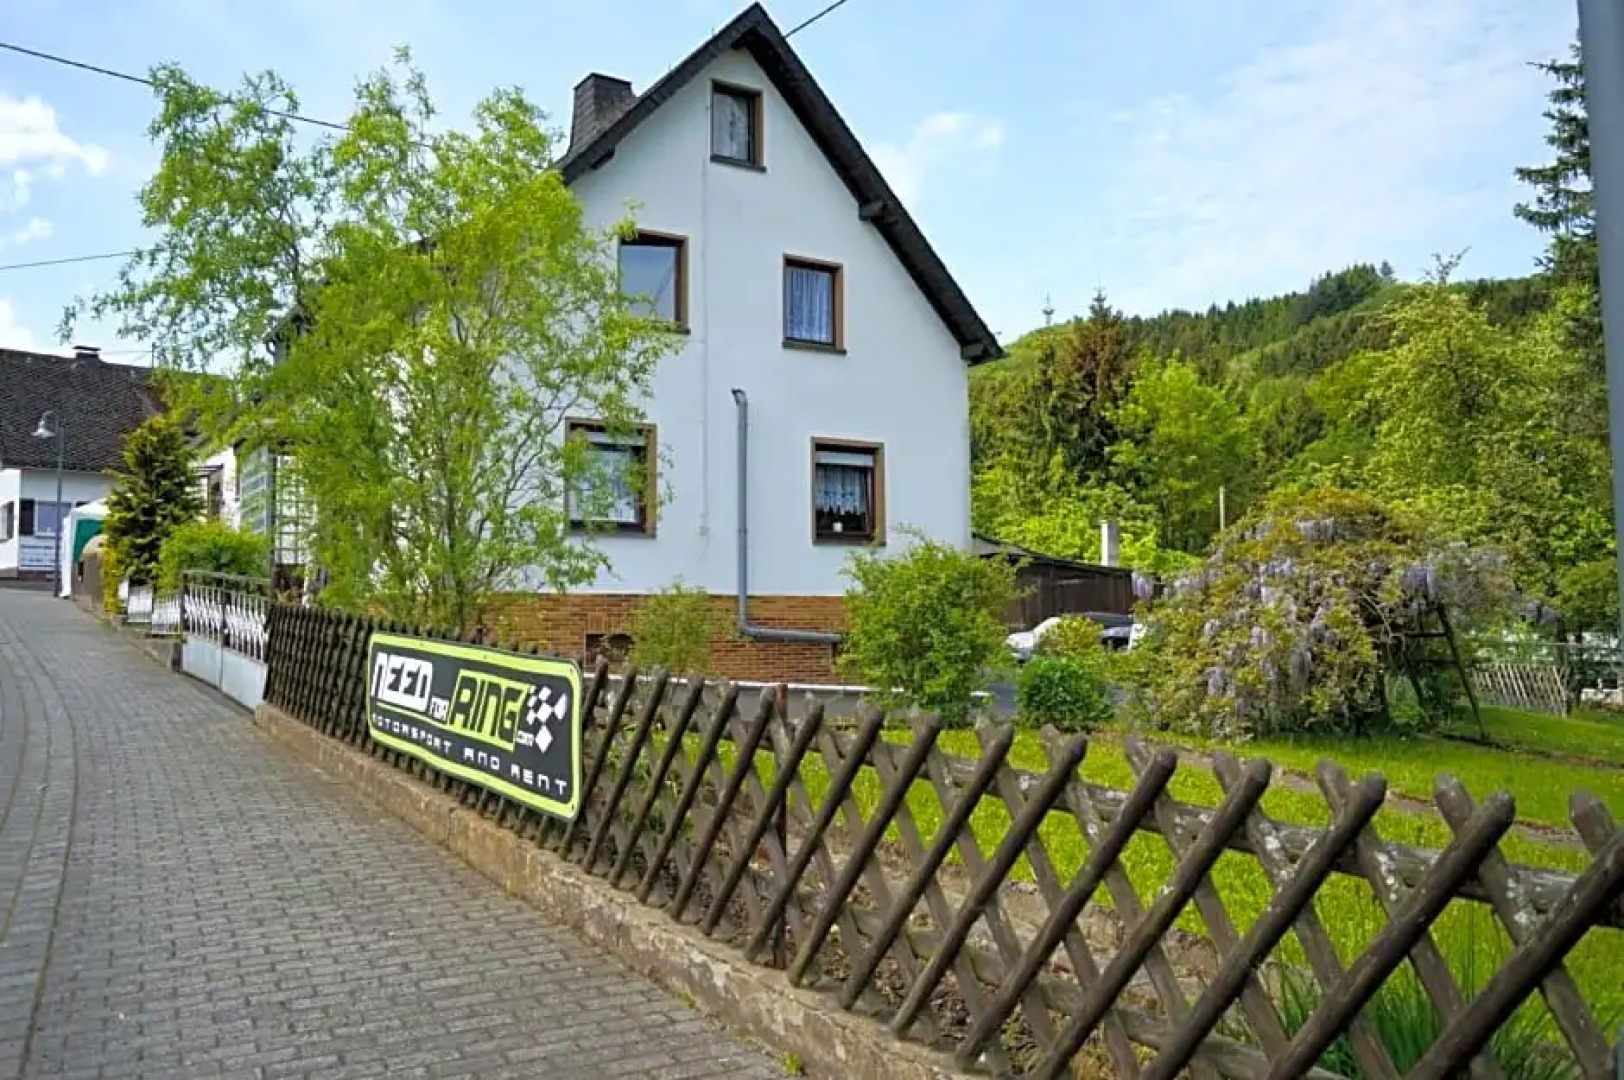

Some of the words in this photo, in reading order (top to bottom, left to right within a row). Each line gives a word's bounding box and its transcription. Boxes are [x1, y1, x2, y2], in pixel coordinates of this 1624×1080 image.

[371, 652, 433, 712] NEED
[449, 669, 527, 751] RING
[463, 747, 501, 770] AND
[511, 764, 568, 796] RENT
